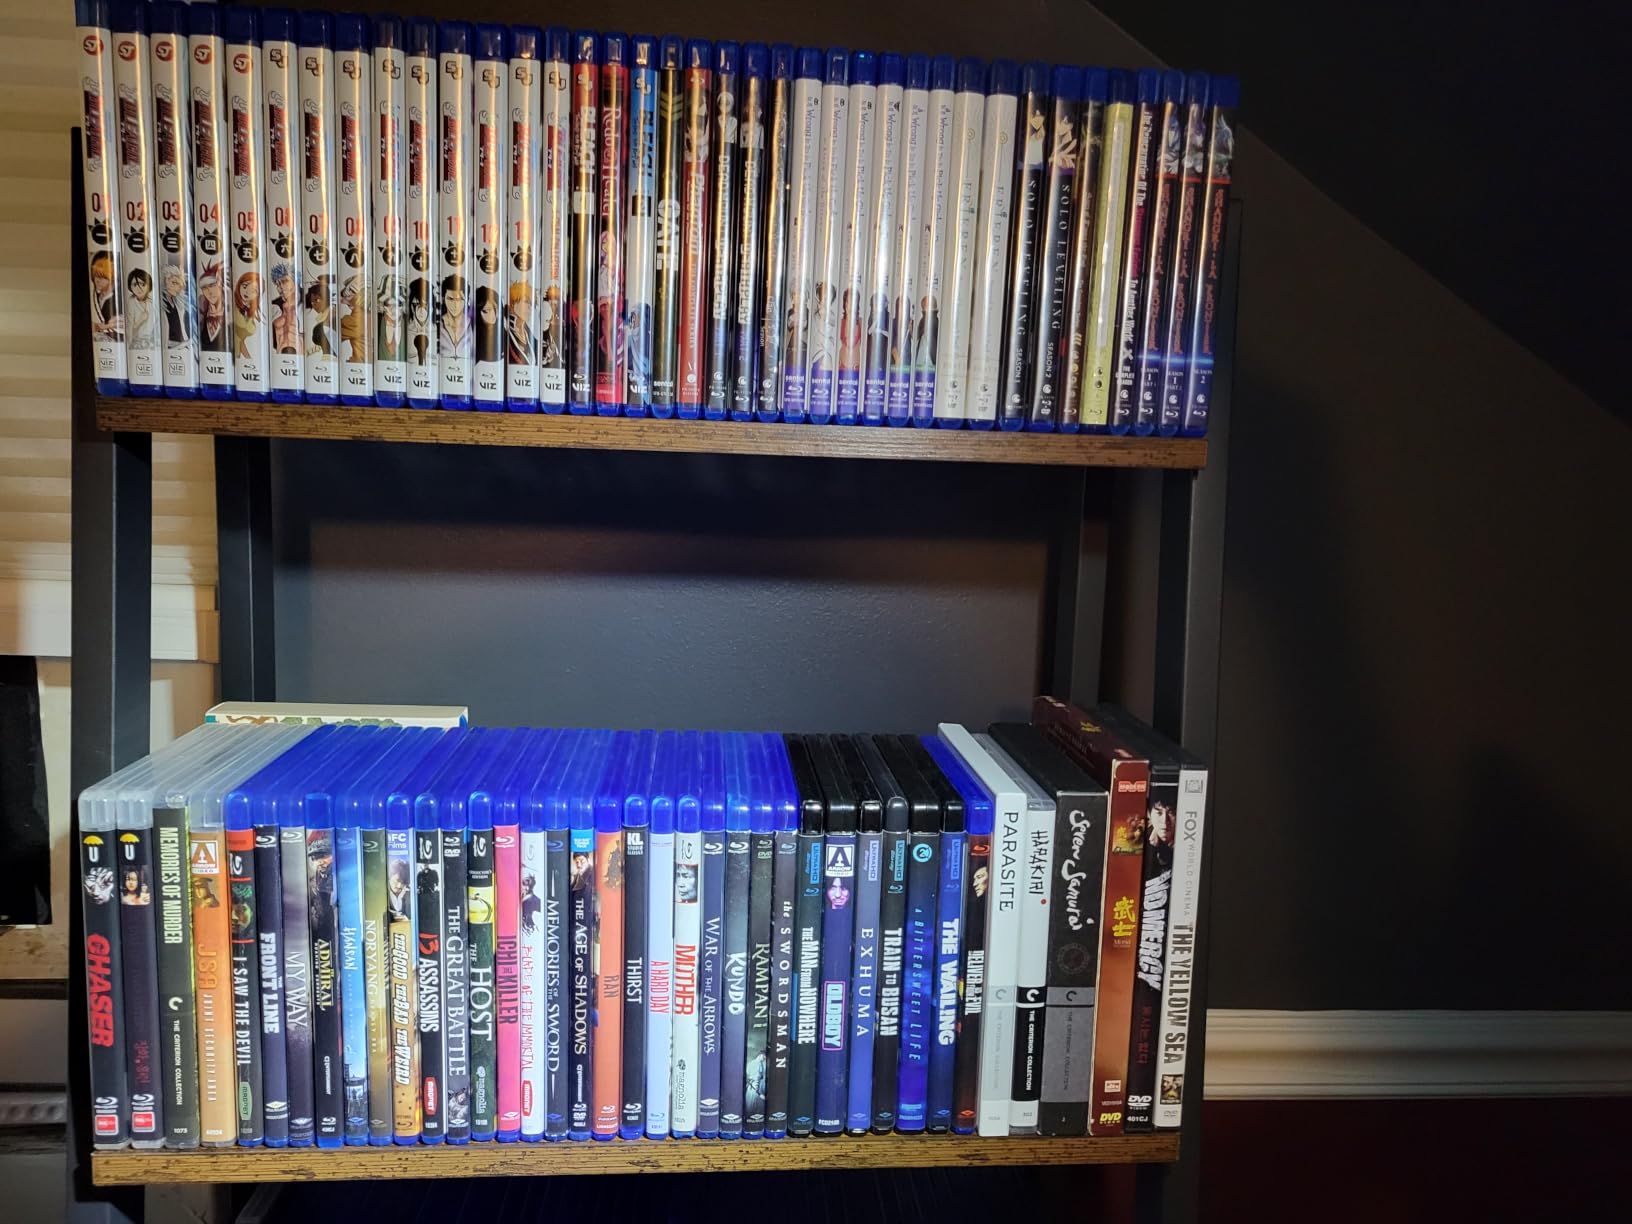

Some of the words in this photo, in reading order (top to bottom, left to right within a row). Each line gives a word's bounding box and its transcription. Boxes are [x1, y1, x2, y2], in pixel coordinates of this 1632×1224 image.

[580, 106, 596, 174] BLEACH
[603, 106, 621, 146] Redo
[1058, 184, 1070, 230] SOLO
[657, 199, 680, 271] GATE
[1051, 241, 1065, 330] LEVELING
[207, 366, 224, 374] VIZ
[242, 373, 260, 381] VIZ
[280, 368, 298, 376] VIZ
[313, 375, 331, 383] VIZ
[348, 377, 366, 385] VIZ
[384, 375, 402, 383] VIZ
[446, 375, 463, 383] VIZ
[1015, 348, 1023, 378] SEASON
[413, 380, 430, 388] VIZ
[513, 378, 531, 387] VIZ
[573, 383, 590, 391] VIZ
[627, 833, 643, 845] KL
[1069, 810, 1091, 860] Seven
[1184, 811, 1197, 842] FOX
[159, 827, 180, 883] MEMORIES
[999, 812, 1019, 912] PARASITE
[1029, 830, 1049, 895] HARAKIRI
[1186, 844, 1194, 876] WORLD
[162, 885, 181, 898] OF
[1061, 859, 1095, 930] Samurai
[1143, 870, 1172, 910] NO
[1184, 881, 1193, 916] CINEMA
[163, 900, 183, 944] MURDER
[447, 906, 460, 934] THE
[575, 898, 585, 920] THE
[782, 901, 792, 917] the
[342, 927, 358, 971] HANSAN
[419, 933, 439, 955] 13
[496, 935, 517, 966] ICHI
[546, 899, 560, 986] MEMORIES
[574, 922, 589, 955] AGE
[704, 917, 720, 954] WAR
[801, 927, 813, 941] THE
[883, 928, 902, 971] TRAIN
[940, 919, 959, 955] THE
[1137, 909, 1167, 991] MERCY
[1171, 923, 1194, 955] THE
[197, 944, 218, 990] JSA
[260, 932, 278, 990] FRONT
[285, 951, 306, 980] MY
[364, 920, 379, 996] NORYANG
[392, 949, 409, 980] GOOD
[446, 935, 464, 1005] GREAT
[574, 959, 584, 972] OF
[651, 960, 666, 968] A
[705, 960, 714, 975] OF
[798, 941, 816, 969] MAN
[910, 921, 925, 1015] BITTERSWEET
[968, 950, 984, 984] DELIVER
[87, 933, 114, 1047] CHASER
[233, 968, 248, 996] SAW
[317, 938, 333, 1011] ADMIRAL
[603, 975, 619, 998] RAN
[626, 957, 642, 1003] THIRST
[650, 969, 668, 995] HARD
[675, 944, 696, 1015] MOTHER
[725, 952, 746, 1015] KUNDO
[799, 968, 811, 988] FROM
[856, 928, 873, 1037] EXHUMA
[885, 974, 897, 984] TO
[203, 993, 214, 1022] JOINT
[286, 986, 308, 1028] WAY
[419, 958, 438, 1032] ASSASSINS
[469, 967, 492, 1041] HOST
[497, 976, 517, 1024] KILLER
[651, 996, 669, 1014] DAY
[775, 928, 791, 1069] SWORDSMAN
[938, 962, 958, 1045] WAILING
[964, 996, 983, 1015] EVIL
[1167, 959, 1191, 1027] YELLOW
[235, 1002, 250, 1025] THE
[263, 994, 279, 1033] LINE
[394, 998, 410, 1025] BAD
[574, 975, 587, 1055] SHADOWS
[703, 994, 718, 1054] ARROWS
[797, 988, 817, 1044] NOWHERE
[824, 983, 843, 1047] OLDBOY
[879, 987, 899, 1036] BUSAN
[236, 1030, 251, 1066] DEVIL
[448, 1006, 466, 1076] BATTLE
[546, 1003, 560, 1071] SWORD
[909, 1023, 924, 1062] LIFE
[1164, 1032, 1185, 1064] SEA
[395, 1045, 411, 1085] WEIRD
[1026, 1056, 1034, 1090] COLLECTION
[175, 1068, 183, 1105] COLLECTION
[677, 1072, 686, 1110] magnolia
[1128, 1095, 1152, 1103] DVD
[1100, 1113, 1121, 1121] DVD
